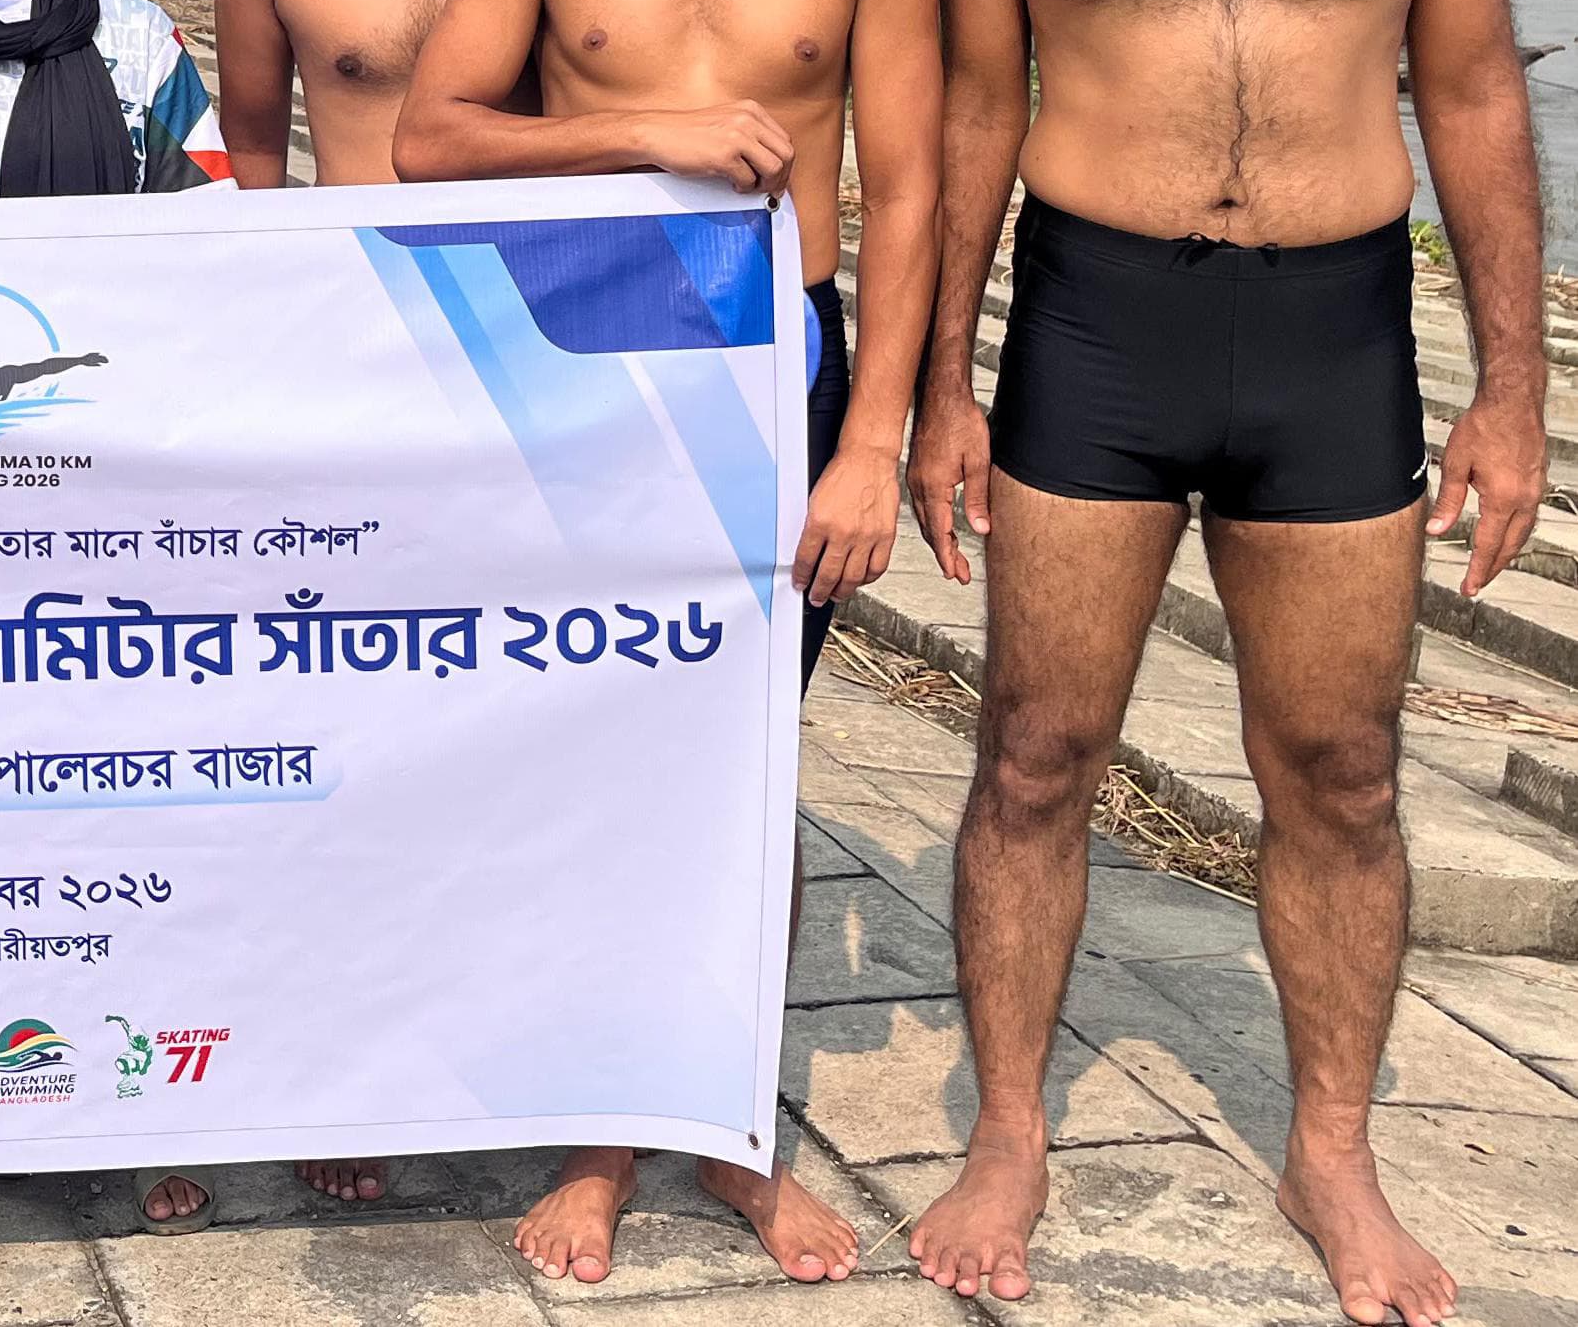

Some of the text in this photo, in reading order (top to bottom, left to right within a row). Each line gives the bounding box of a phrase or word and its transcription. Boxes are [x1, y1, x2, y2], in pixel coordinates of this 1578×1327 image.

[13, 474, 59, 487] 2026
[36, 456, 55, 468] 10
[61, 456, 91, 468] KM
[64, 529, 143, 559] মানে
[151, 520, 243, 559] বাঁচার
[254, 588, 483, 678] সাঁতার
[504, 602, 722, 672] ২০২৬
[188, 742, 318, 788] বাজার
[59, 873, 171, 910] ২০২৬
[156, 1028, 230, 1044] SKATING
[166, 1045, 212, 1083] 71
